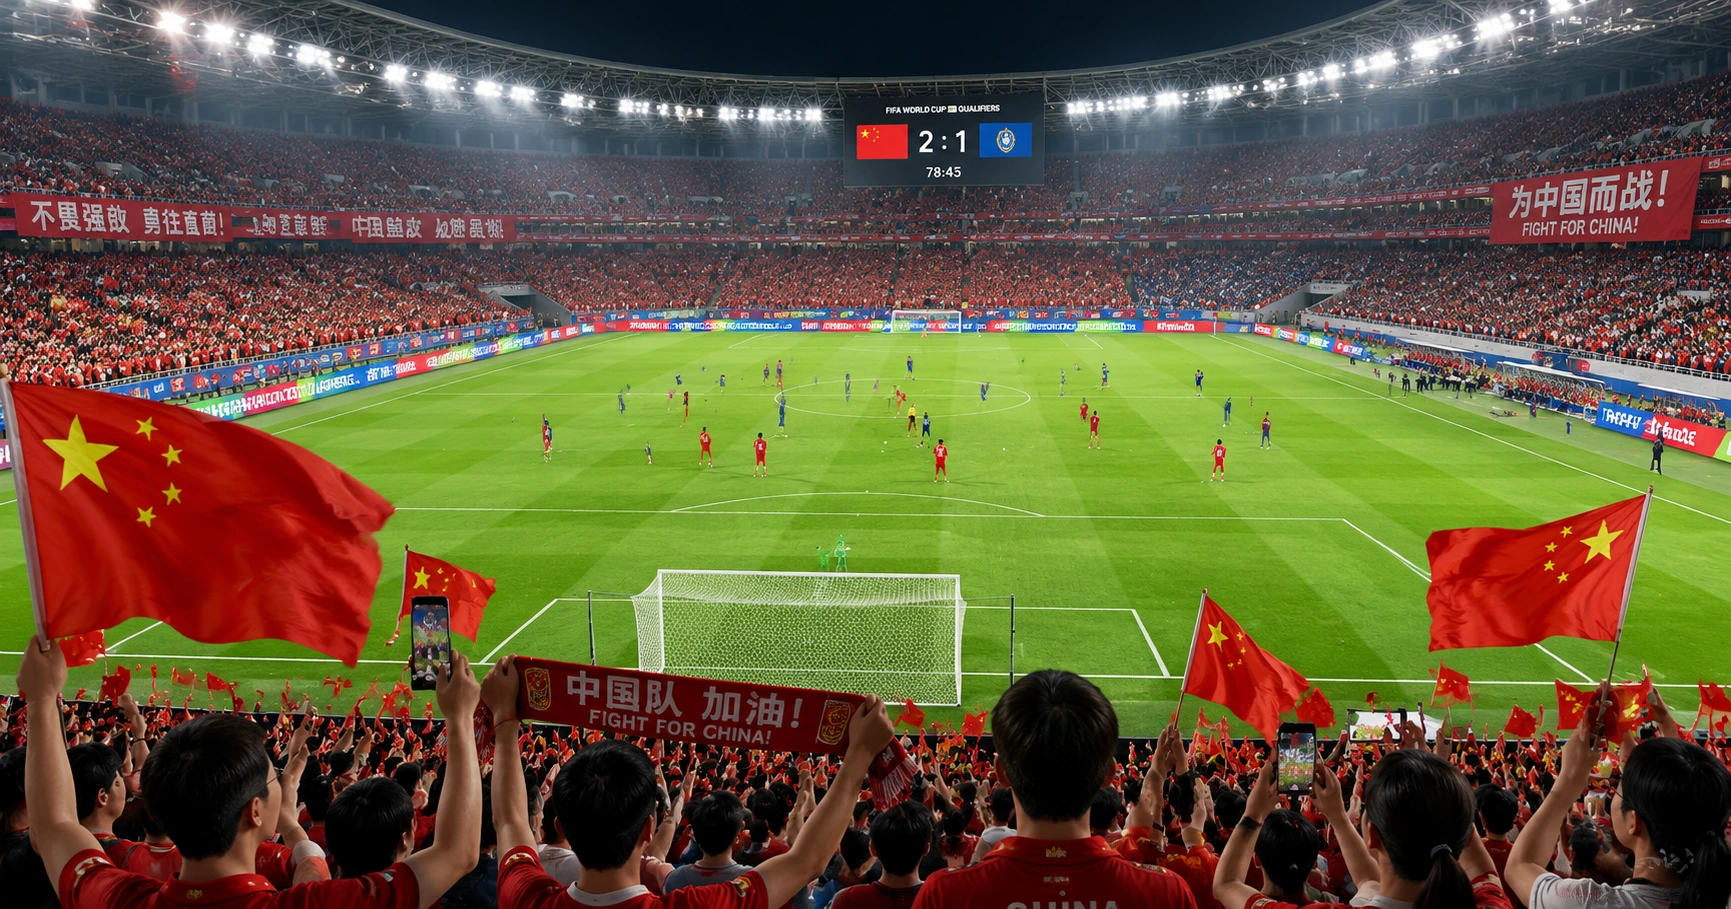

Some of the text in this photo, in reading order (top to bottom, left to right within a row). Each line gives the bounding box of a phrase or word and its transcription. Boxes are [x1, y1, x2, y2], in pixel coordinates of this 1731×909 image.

[885, 106, 902, 114] FIFA
[902, 106, 930, 114] WORLD
[931, 105, 947, 113] CUP
[958, 104, 1001, 113] QUALIFIERS
[926, 166, 961, 178] 78:45
[1508, 169, 1669, 219] 为中国而战!
[1522, 216, 1639, 237] FIGHT FOR CHINA!
[566, 670, 804, 729] 中国队 加油!
[588, 708, 772, 746] FIGHT FOR CHINA!
